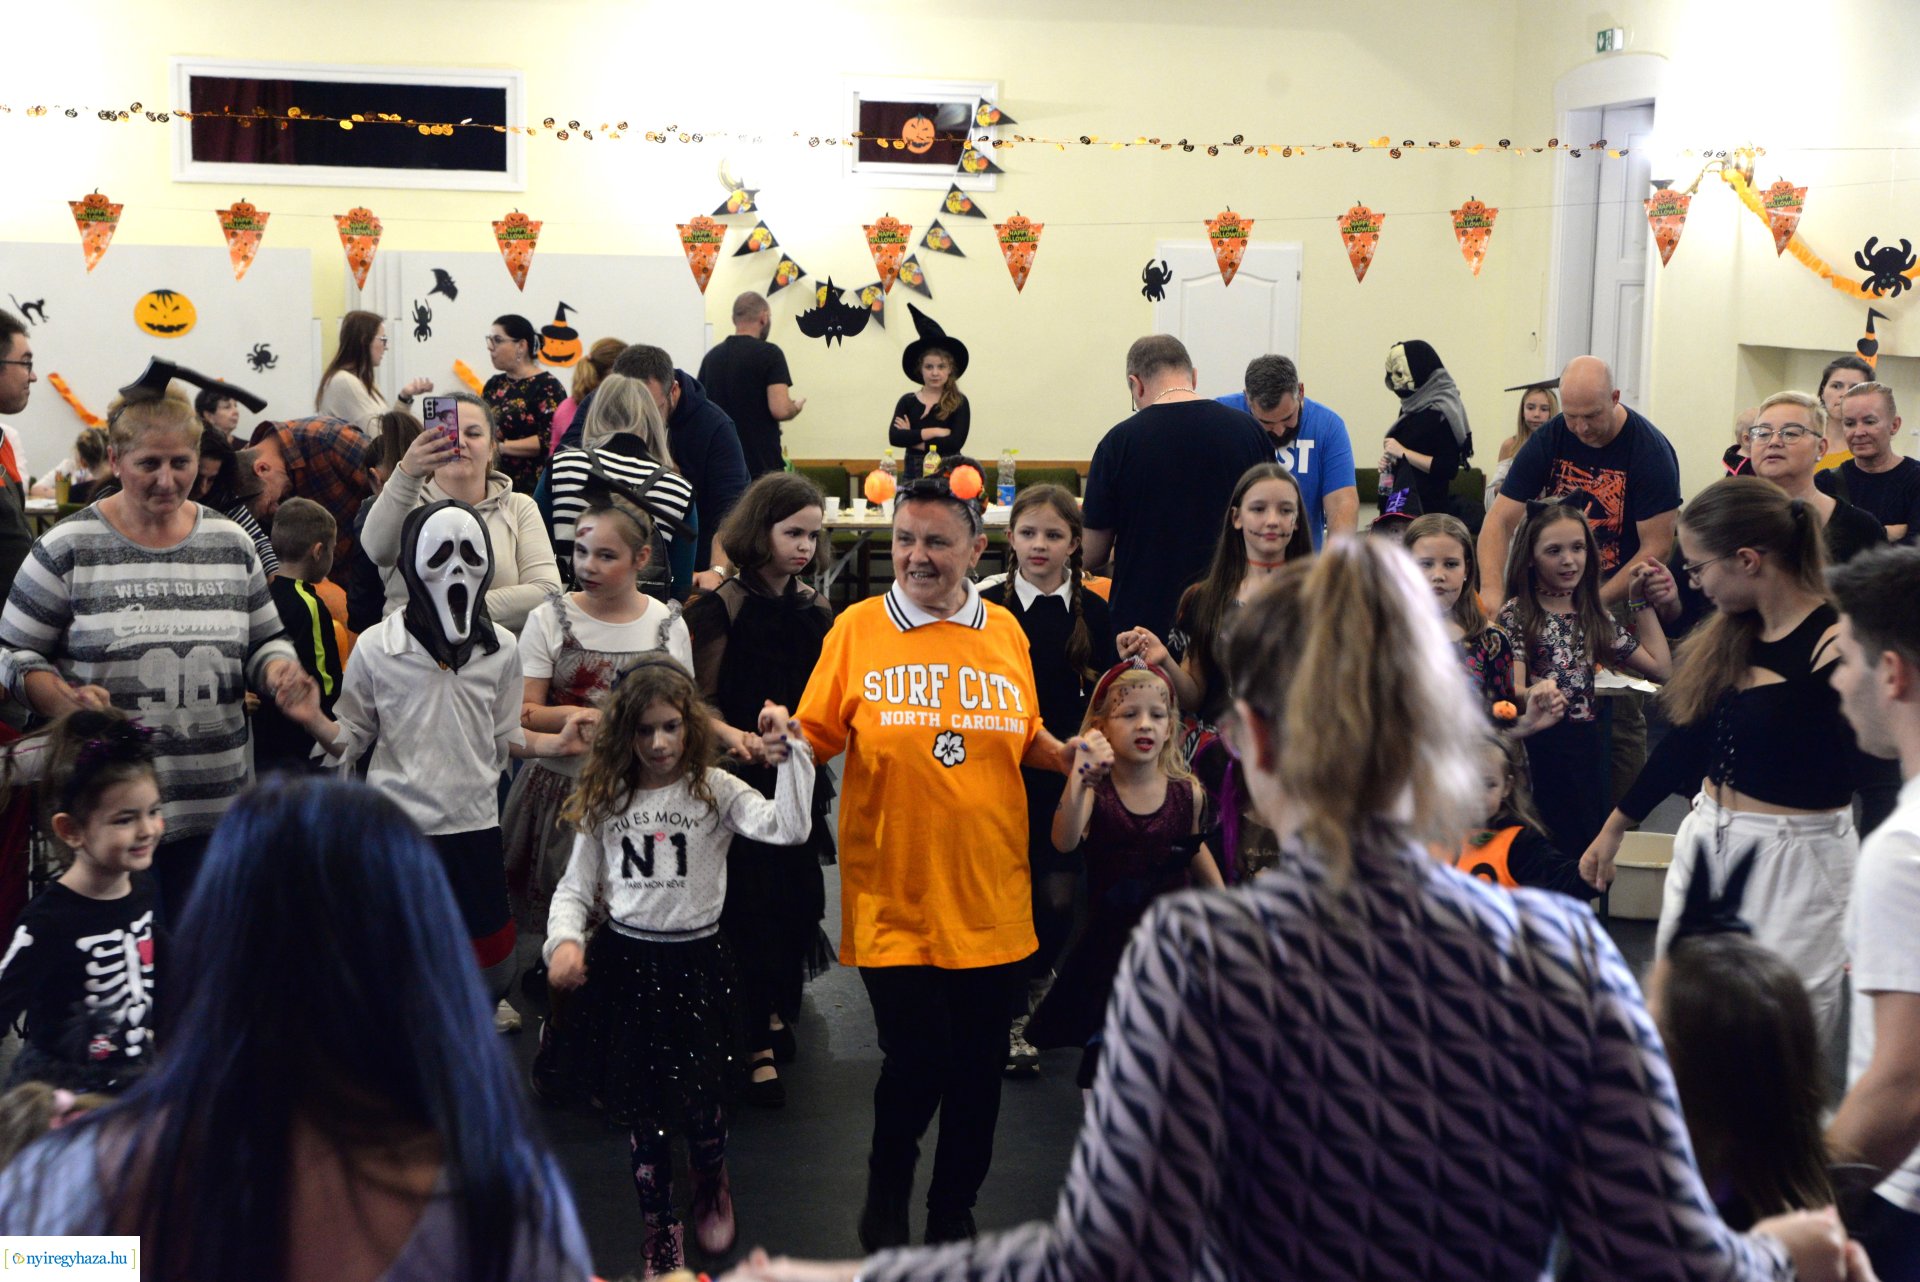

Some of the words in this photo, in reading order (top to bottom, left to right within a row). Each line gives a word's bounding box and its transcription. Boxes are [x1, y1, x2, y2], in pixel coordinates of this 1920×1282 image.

[114, 582, 169, 599] WEST
[175, 581, 225, 597] COAST
[863, 664, 949, 708] SURF
[958, 665, 1023, 712] CITY
[880, 711, 941, 728] NORTH
[951, 714, 1025, 735] CAROLINA
[633, 811, 650, 825] ES
